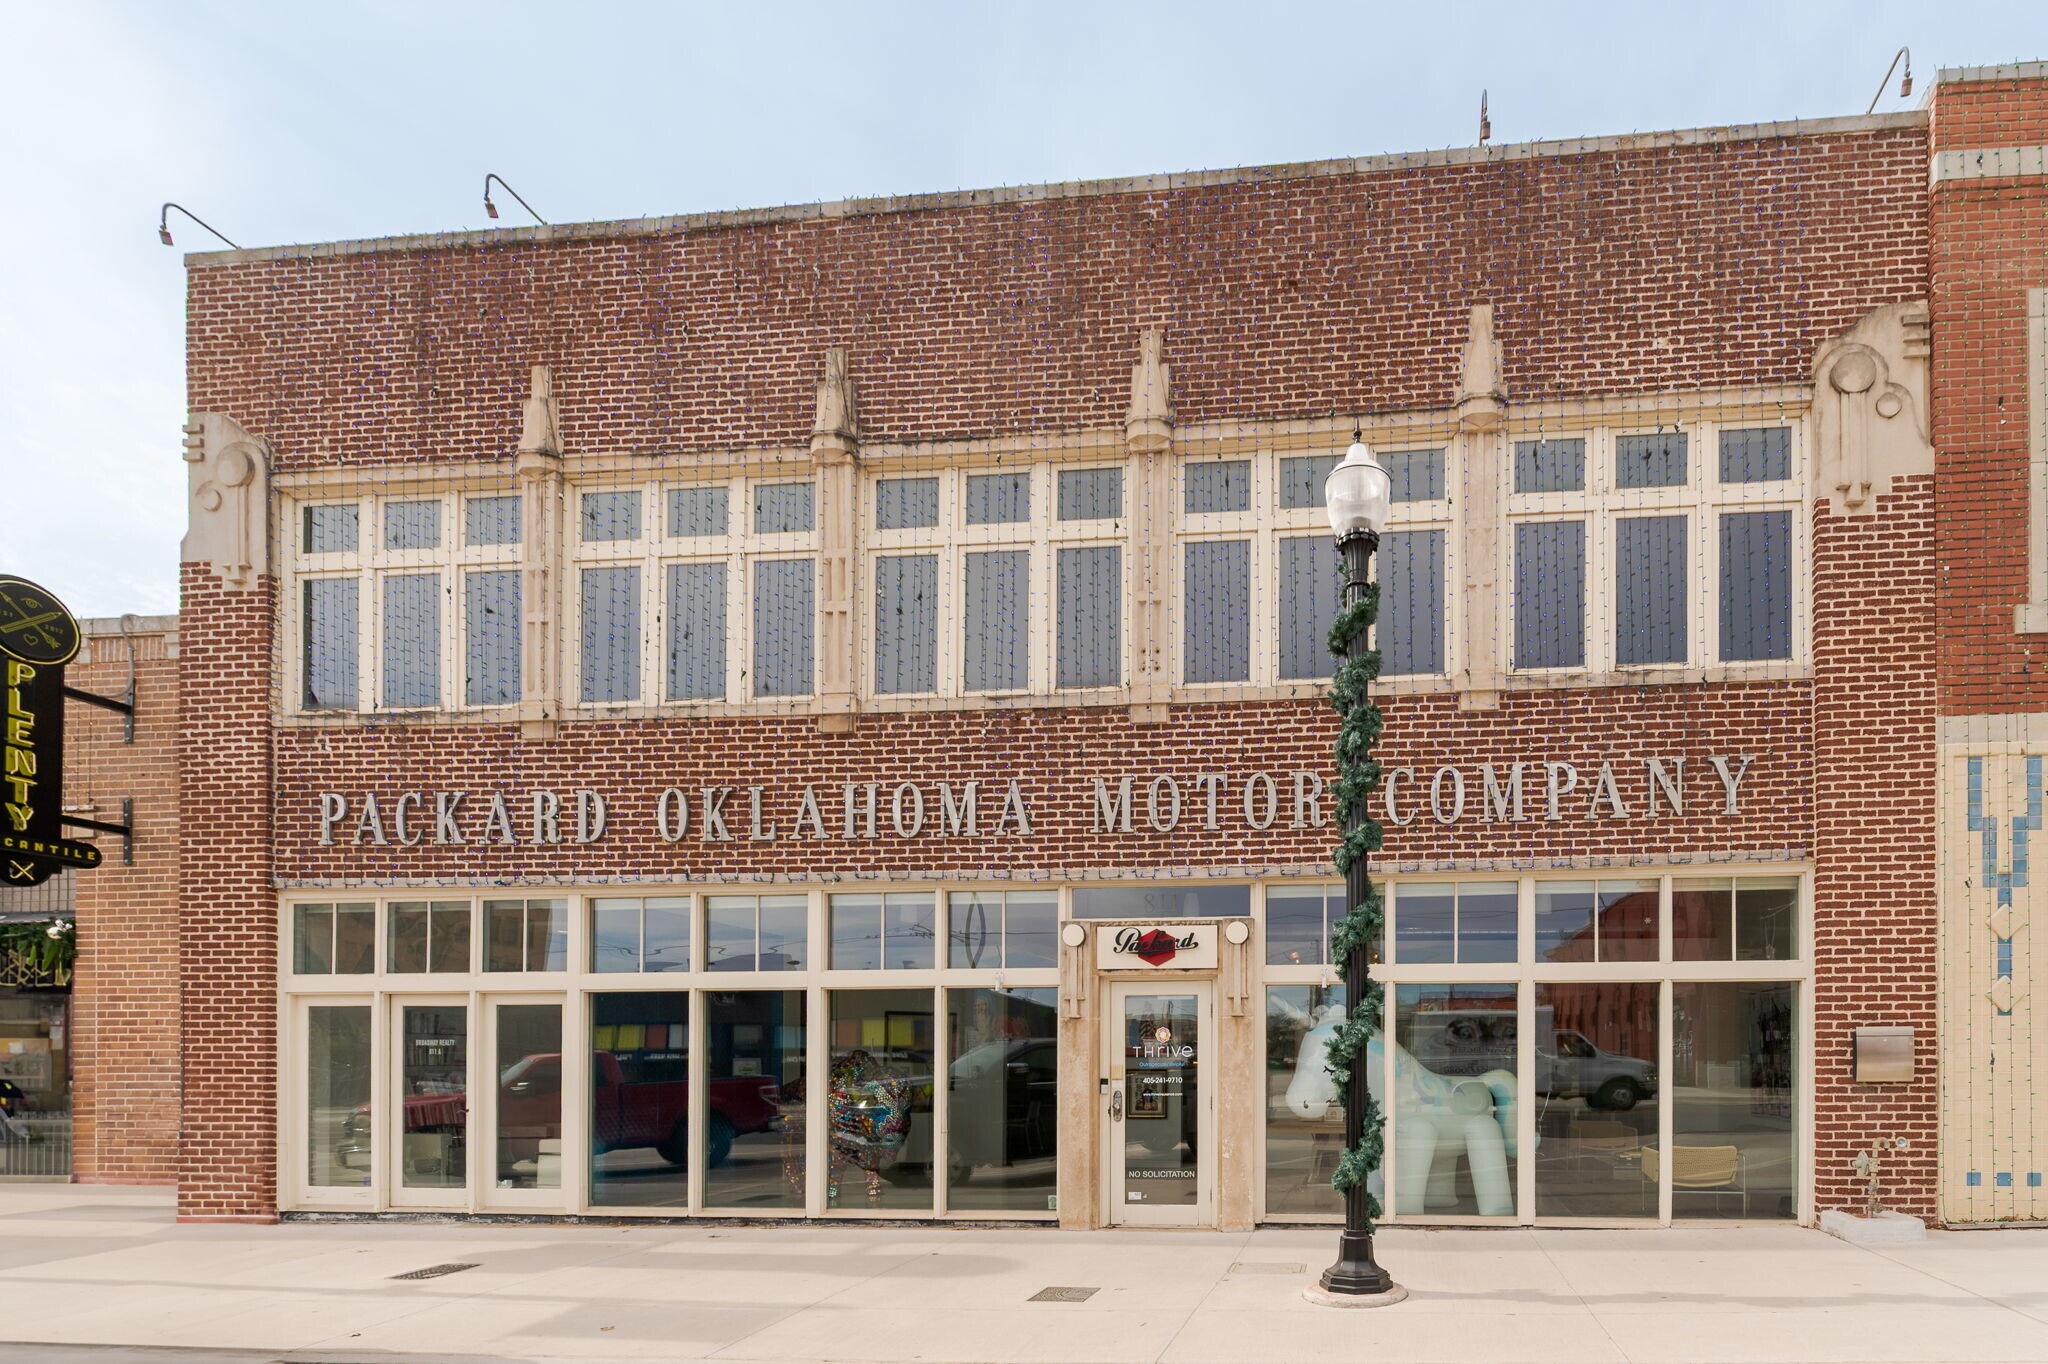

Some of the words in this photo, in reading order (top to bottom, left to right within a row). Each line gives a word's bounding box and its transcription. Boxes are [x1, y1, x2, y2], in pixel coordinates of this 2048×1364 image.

[5, 659, 38, 832] PLENTY
[319, 790, 610, 846] PACKARD
[657, 779, 1032, 843] OKLAHOMA
[1090, 769, 1328, 834] MOTOR
[1384, 754, 1755, 826] COMPANY
[1144, 892, 1177, 914] 811
[1114, 926, 1199, 957] Packard
[1142, 1076, 1183, 1084] 405-241-9710
[1128, 1170, 1141, 1178] NO
[1142, 1170, 1196, 1178] SOLICITATION
